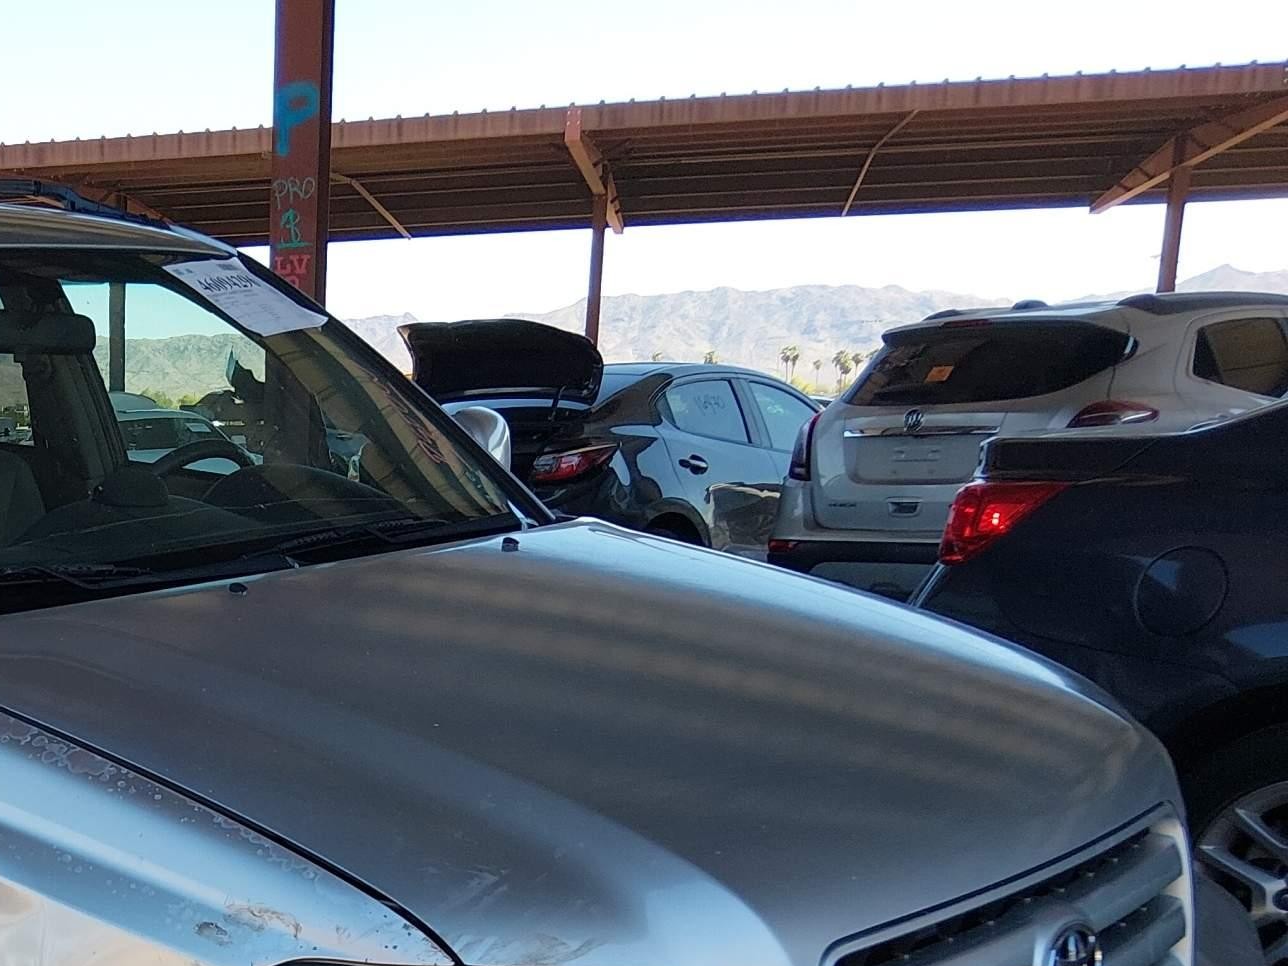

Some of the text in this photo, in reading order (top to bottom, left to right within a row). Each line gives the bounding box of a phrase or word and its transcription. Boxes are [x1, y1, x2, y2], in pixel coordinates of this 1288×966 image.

[275, 80, 319, 157] P
[272, 176, 316, 210] PRO
[275, 253, 312, 275] LV
